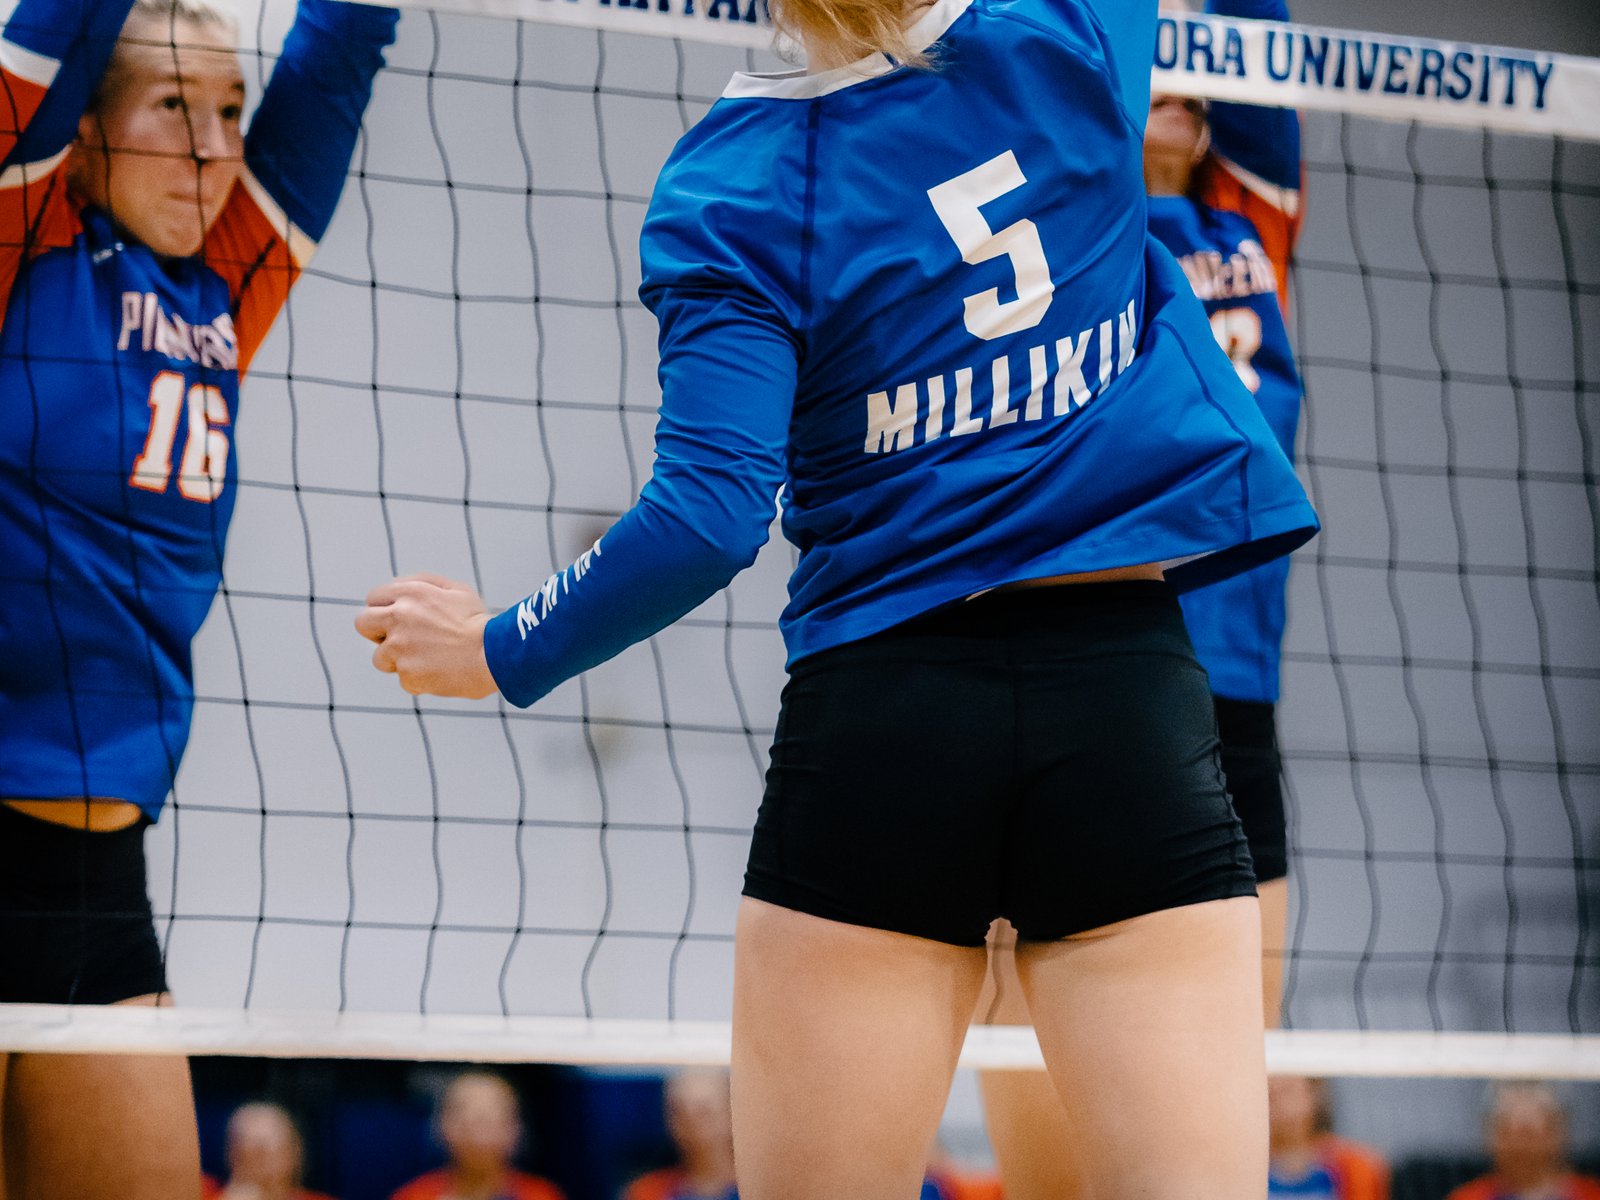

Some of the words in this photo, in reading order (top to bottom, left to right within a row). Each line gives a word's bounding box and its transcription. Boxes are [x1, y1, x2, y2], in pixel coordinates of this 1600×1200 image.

[1152, 18, 1246, 77] ORA
[1266, 30, 1554, 109] UNIVERSITY
[927, 149, 1055, 341] 5
[127, 369, 230, 503] 16
[864, 298, 1136, 454] MILLIKIN
